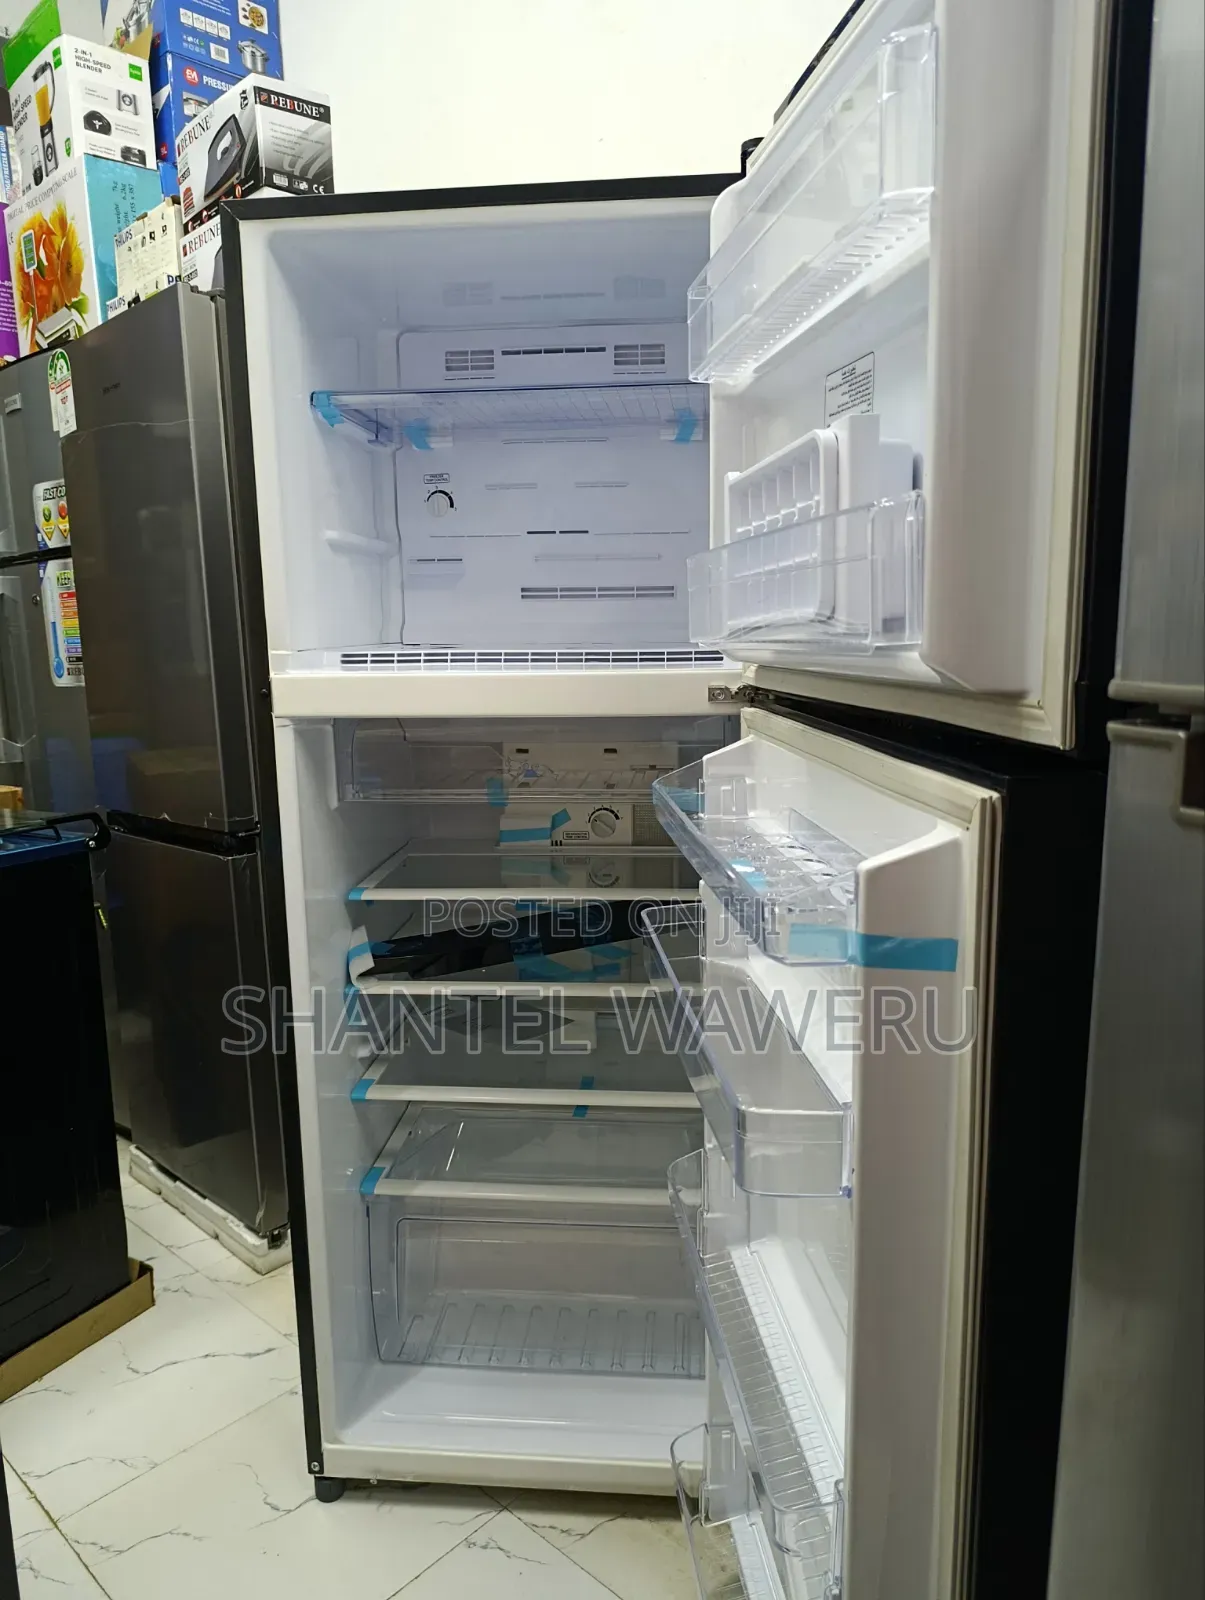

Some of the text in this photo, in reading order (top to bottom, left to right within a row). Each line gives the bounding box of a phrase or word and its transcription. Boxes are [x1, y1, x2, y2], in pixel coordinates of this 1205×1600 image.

[75, 54, 112, 70] HIGH-SPEED
[76, 61, 103, 74] BLENDER
[61, 167, 78, 183] SCALE
